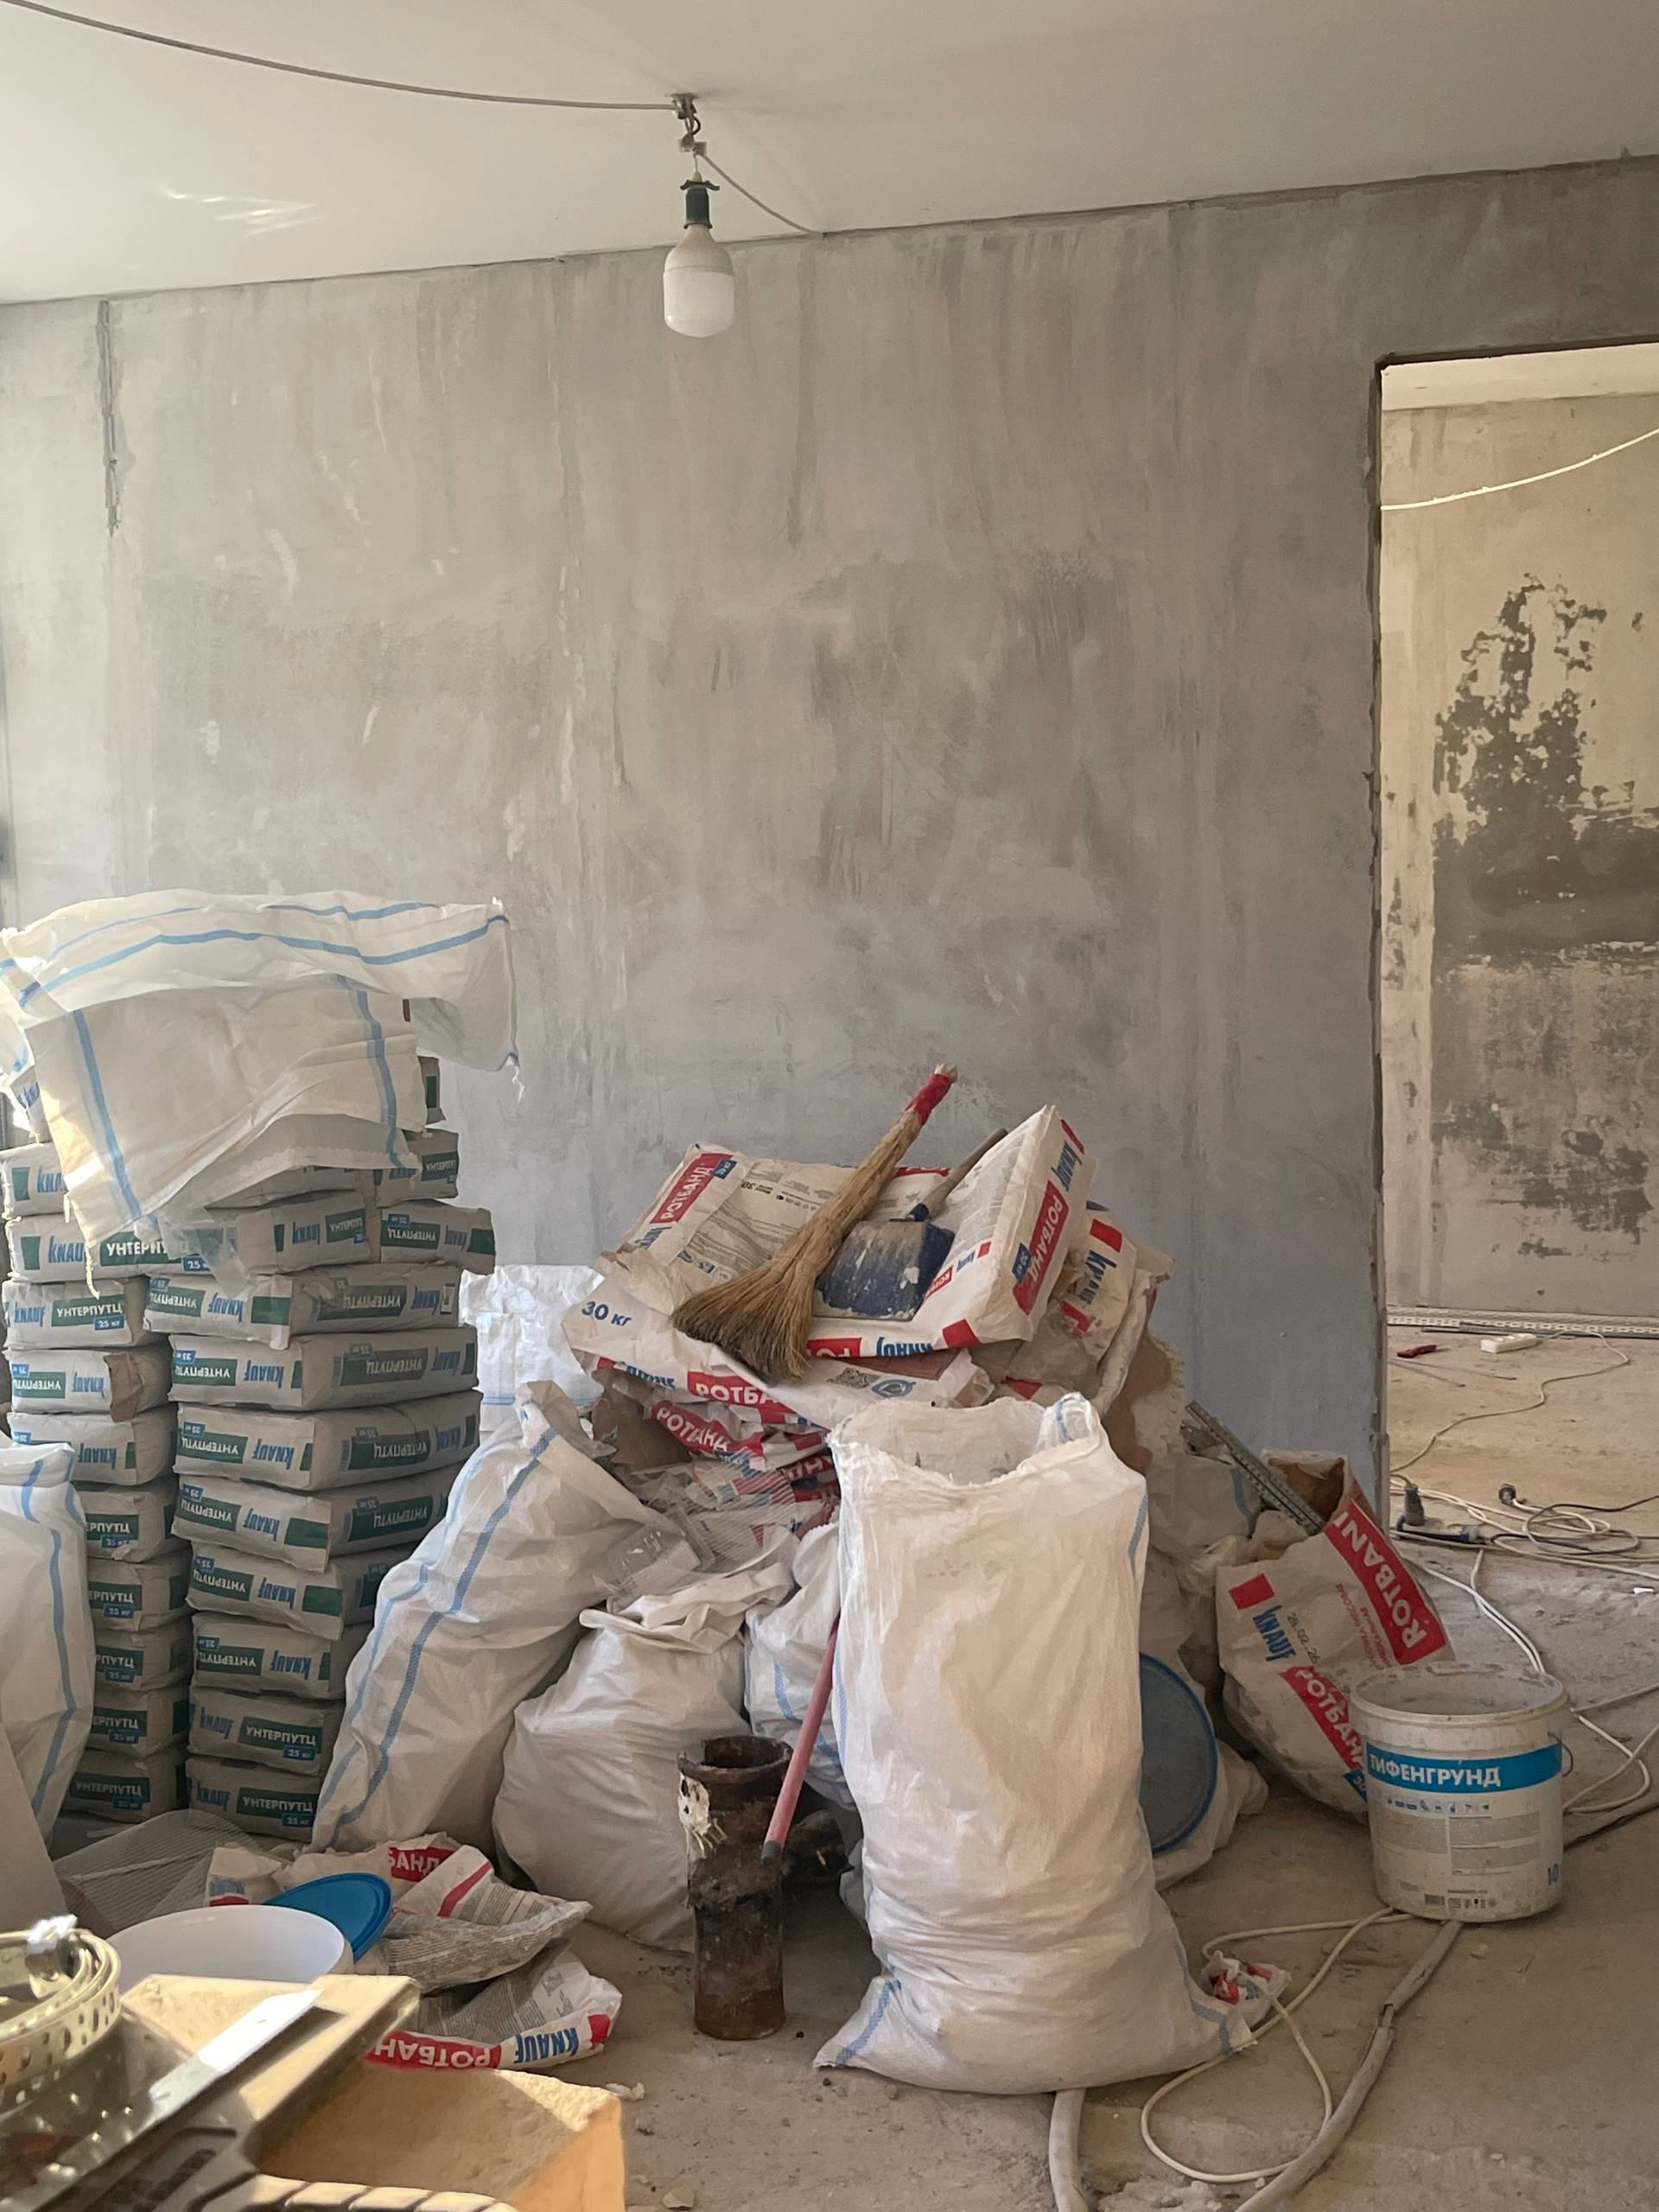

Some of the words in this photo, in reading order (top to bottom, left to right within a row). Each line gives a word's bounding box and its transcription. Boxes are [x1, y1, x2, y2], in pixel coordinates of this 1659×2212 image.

[48, 1236, 86, 1262] KNAU
[1026, 1194, 1063, 1282] РОТБАНД
[187, 1261, 200, 1269] 25
[14, 1302, 44, 1327] KNAUF
[57, 1302, 122, 1318] УНТЕРПУТЦ
[207, 1293, 243, 1322] KNAUF
[582, 1301, 609, 1320] 30
[611, 1313, 632, 1326] кг
[99, 1319, 109, 1328] 25
[72, 1372, 104, 1398] KNAUF
[244, 1360, 283, 1389] KNAUF
[696, 1382, 774, 1404] РОТБА
[658, 1406, 727, 1452] РОТАНД
[79, 1443, 116, 1468] KNAUF
[181, 1438, 238, 1454] УНТЕРПУТЦ
[252, 1440, 295, 1469] KNAUF
[86, 1522, 130, 1534] ЕРПУТЦ
[244, 1509, 280, 1541] KNAUF
[89, 1592, 133, 1603] ЕРПУТЦ
[257, 1578, 296, 1609] KNAUF
[1253, 1605, 1296, 1662] KNAUF
[97, 1656, 133, 1669] РПУТЦ
[270, 1650, 312, 1680] KNAUF
[93, 1718, 138, 1729] ЕРПУТЦ
[202, 1707, 234, 1739] KNAUF
[1295, 1669, 1364, 1765] РОТБАН
[245, 1726, 316, 1745] УНТЕРПУТЦ
[1369, 1754, 1501, 1788] ТИФЕНГРУНД
[76, 1781, 141, 1796] УНТЕРПУТЦ
[243, 1796, 314, 1813] УНТЕРПУТЦ
[390, 1847, 441, 1875] БАНД
[374, 2039, 491, 2069] РОТБАН
[514, 2027, 579, 2063] KNAUF
